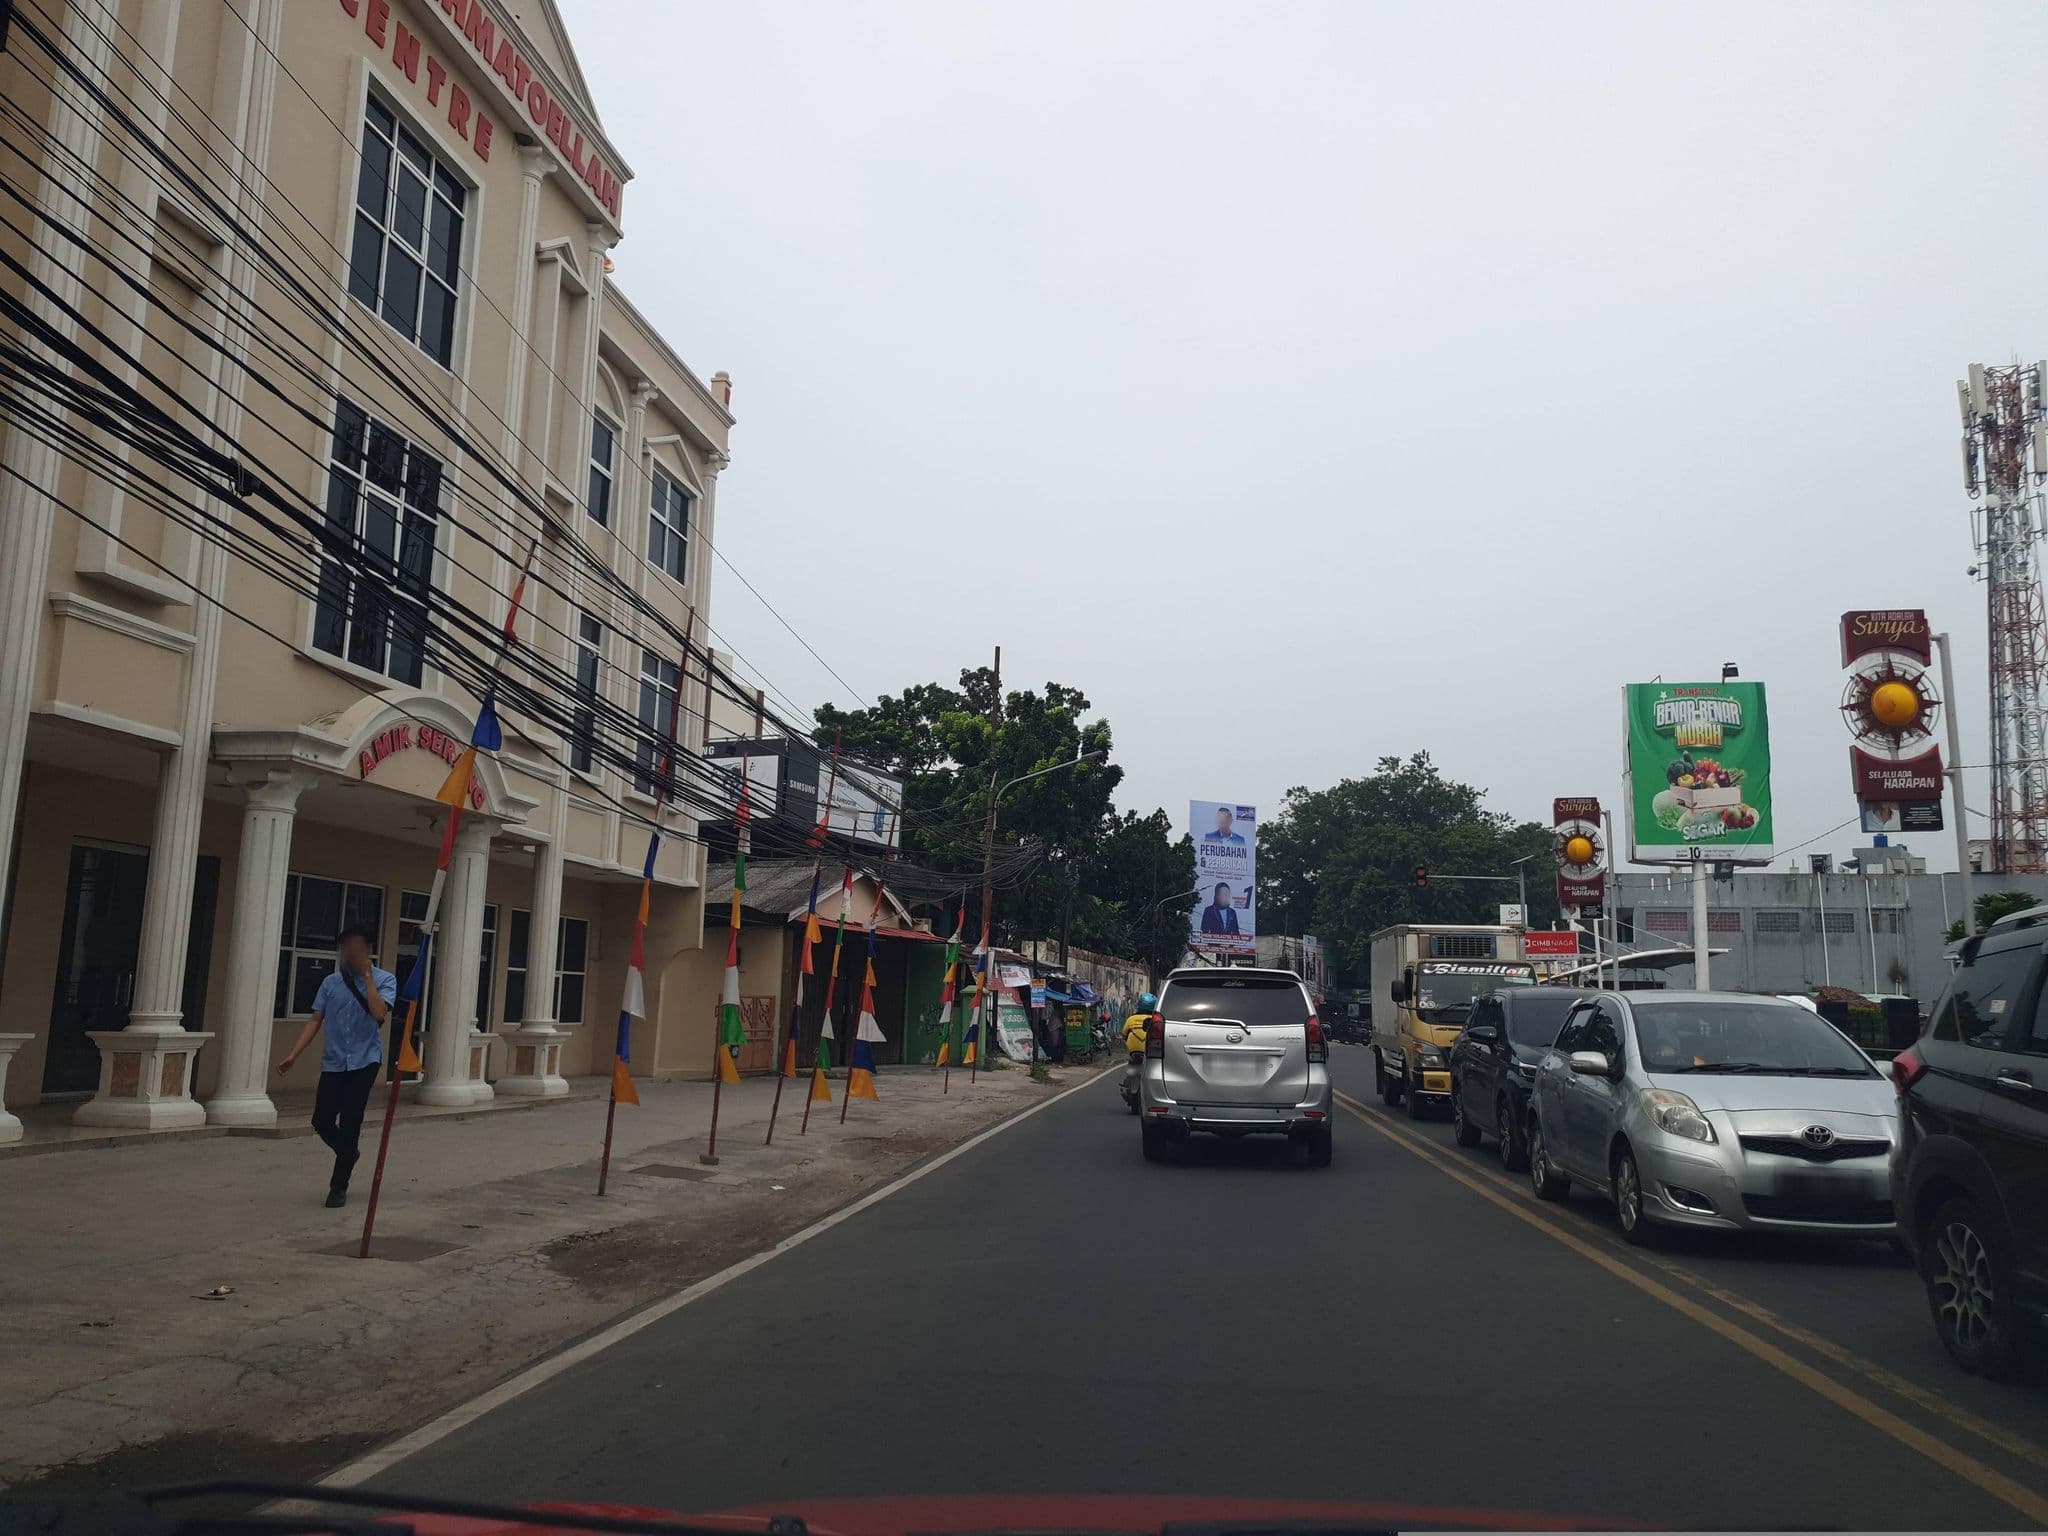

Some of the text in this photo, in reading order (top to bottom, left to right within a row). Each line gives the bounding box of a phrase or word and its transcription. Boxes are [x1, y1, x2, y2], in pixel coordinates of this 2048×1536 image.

[1853, 615, 1924, 642] Surya
[1656, 699, 1740, 727] BENAR-BENAR
[1676, 722, 1722, 746] MURAH
[361, 723, 485, 809] AMIK SERNG
[1868, 770, 1912, 779] SELALU ADA
[790, 779, 815, 795] SAMSUNG
[1883, 777, 1935, 789] HARAPAN
[1558, 800, 1597, 816] Surya
[1683, 821, 1725, 840] SEGAR
[1200, 844, 1247, 858] PERUBAHAN
[1689, 847, 1700, 859] 10
[1532, 939, 1574, 947] CIMB NIAGA
